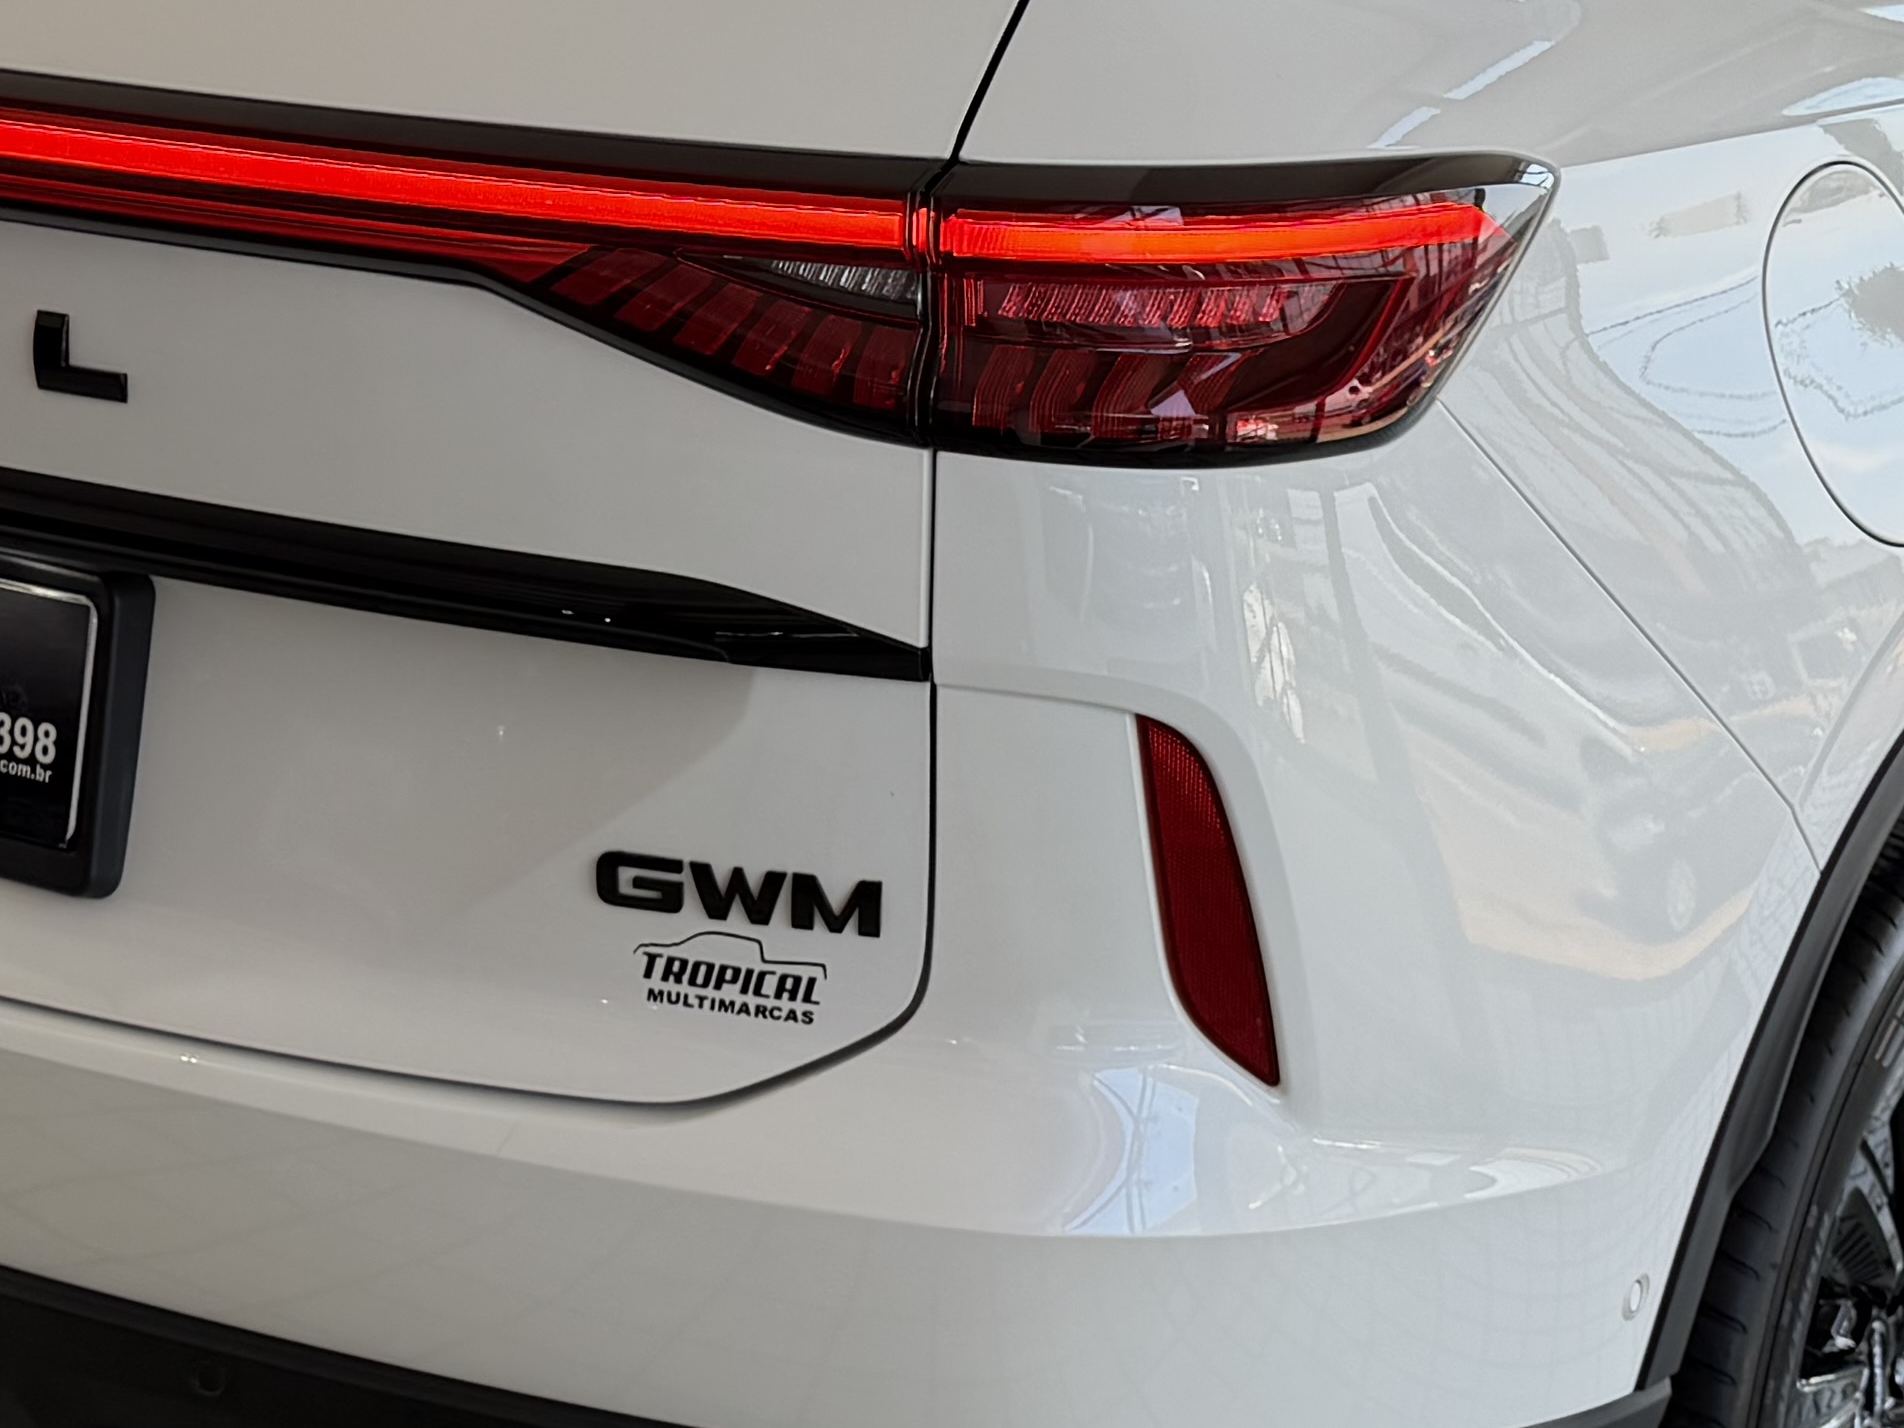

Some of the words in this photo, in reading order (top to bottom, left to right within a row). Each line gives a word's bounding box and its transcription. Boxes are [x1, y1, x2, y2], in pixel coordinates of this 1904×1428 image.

[595, 850, 883, 939] GWM
[641, 951, 821, 1006] TROPICAL
[646, 986, 815, 1025] MULTIMARCAS
